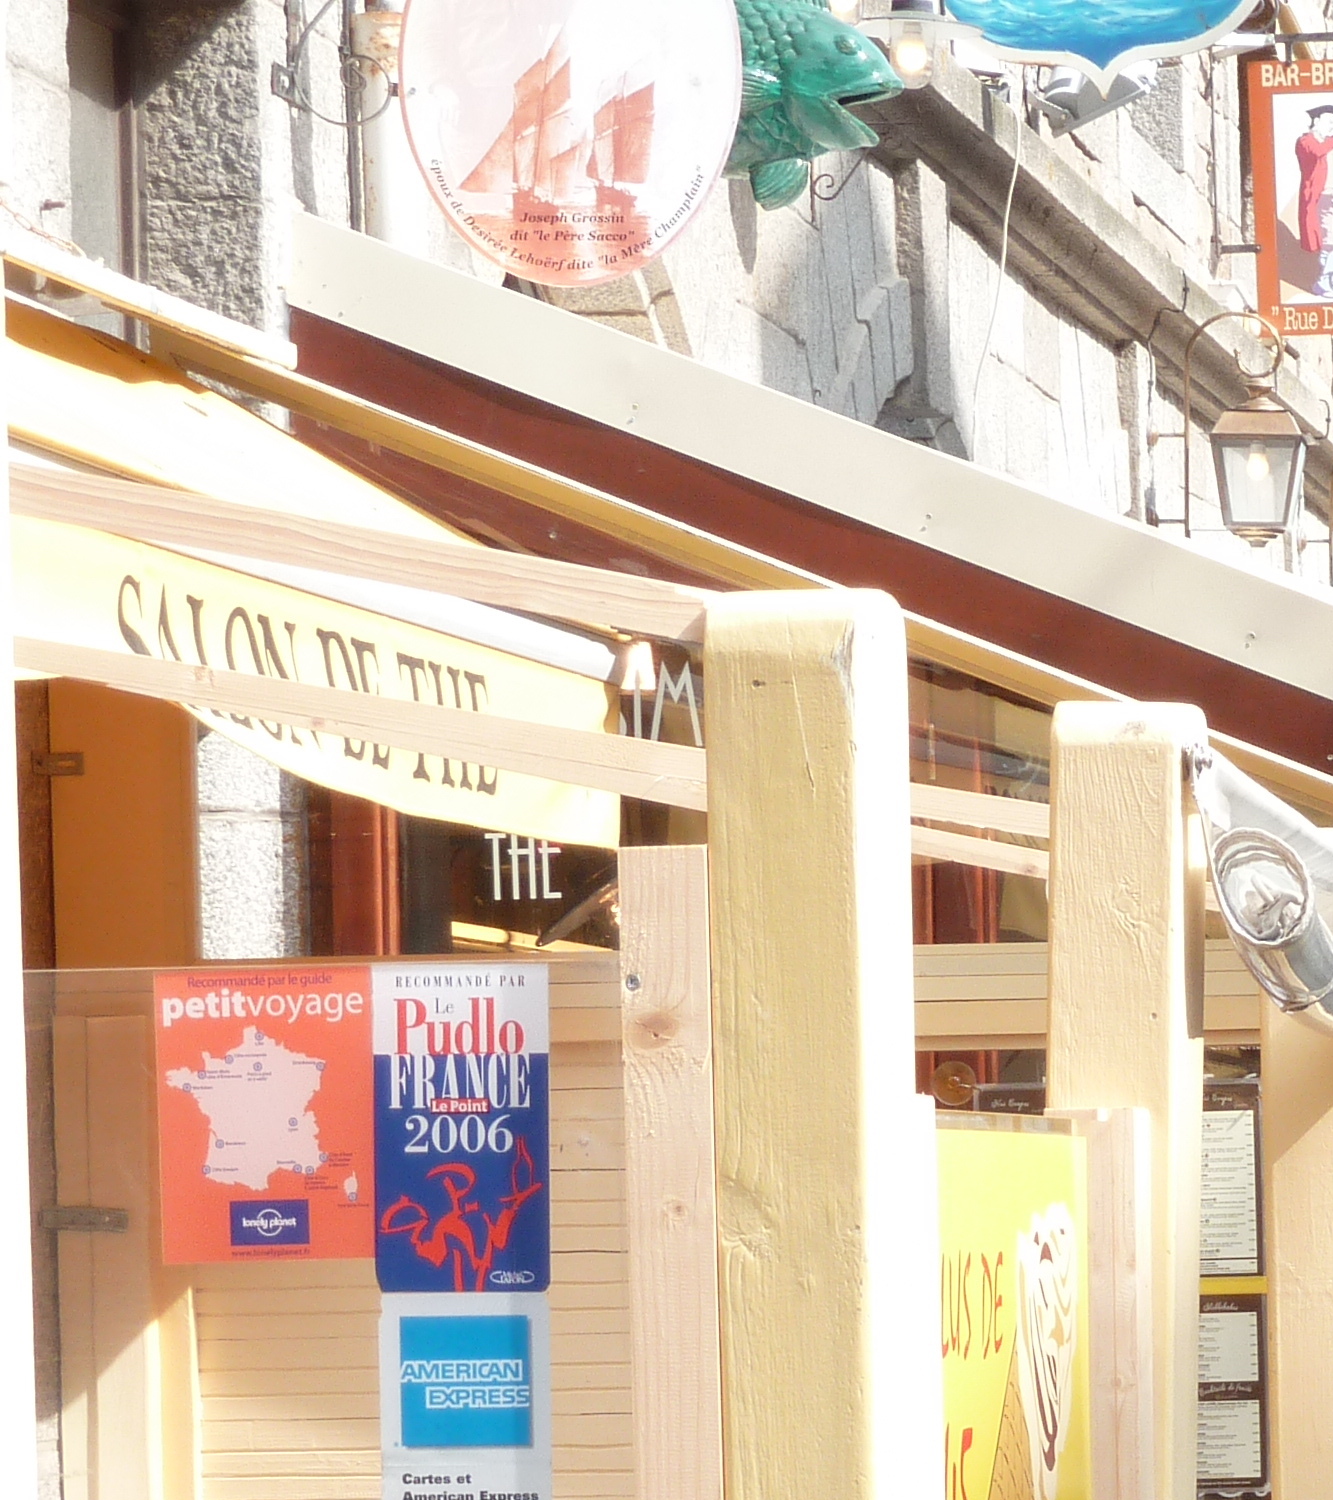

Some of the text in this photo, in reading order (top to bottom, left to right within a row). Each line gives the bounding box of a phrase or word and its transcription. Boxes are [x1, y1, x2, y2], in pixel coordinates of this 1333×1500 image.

[430, 158, 452, 199] époux
[450, 198, 465, 215] de
[567, 257, 594, 271] dite
[621, 236, 655, 261] Mère
[519, 211, 625, 226] Joseph Grossin
[510, 230, 528, 241] dit
[554, 229, 585, 242] Père
[1283, 308, 1319, 331] Rue
[316, 626, 391, 770] DE
[187, 972, 333, 988] Recommandé par le guide
[396, 973, 526, 988] RECOMMANDÉ PAR
[163, 988, 364, 1028] petitvoyage
[435, 997, 455, 1014] Le
[393, 997, 525, 1056] Pudlo
[389, 1052, 531, 1109] FRANCE
[431, 1099, 489, 1113] Le Point
[404, 1114, 514, 1153] 2006
[401, 1358, 523, 1383] AMERICAN
[425, 1385, 530, 1409] EXPRESS
[402, 1472, 472, 1486] Cartes et
